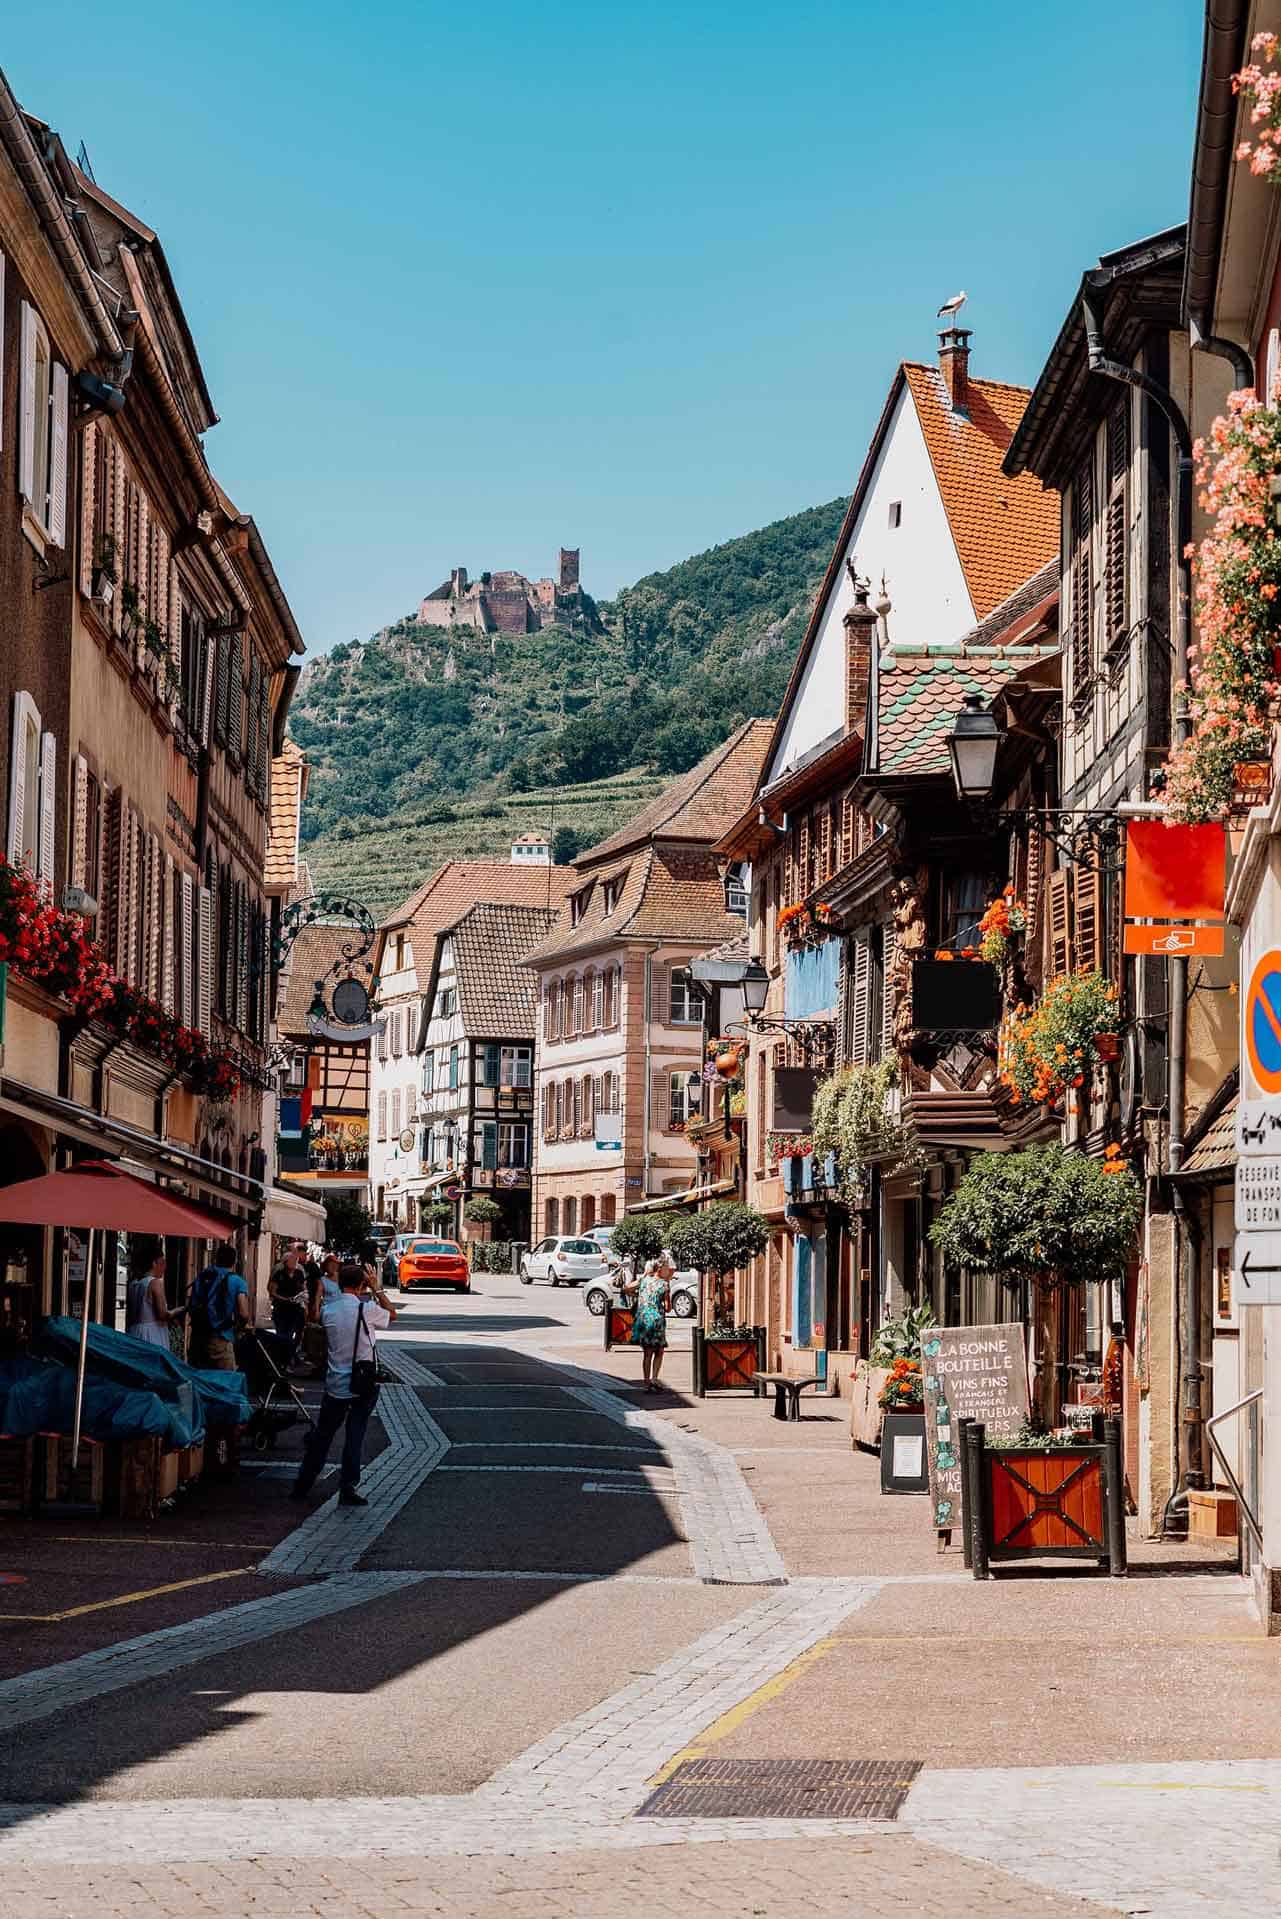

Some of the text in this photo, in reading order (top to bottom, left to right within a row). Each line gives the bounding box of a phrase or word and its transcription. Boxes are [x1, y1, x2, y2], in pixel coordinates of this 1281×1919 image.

[1247, 1208, 1257, 1221] DE
[937, 1339, 1009, 1357] LA BONNE
[936, 1356, 1013, 1373] BOUTEILLE
[950, 1375, 1009, 1391] VINS FINS
[951, 1405, 1020, 1421] SPIRITUEUX
[986, 1420, 1011, 1433] ERS
[937, 1471, 961, 1482] MIG
